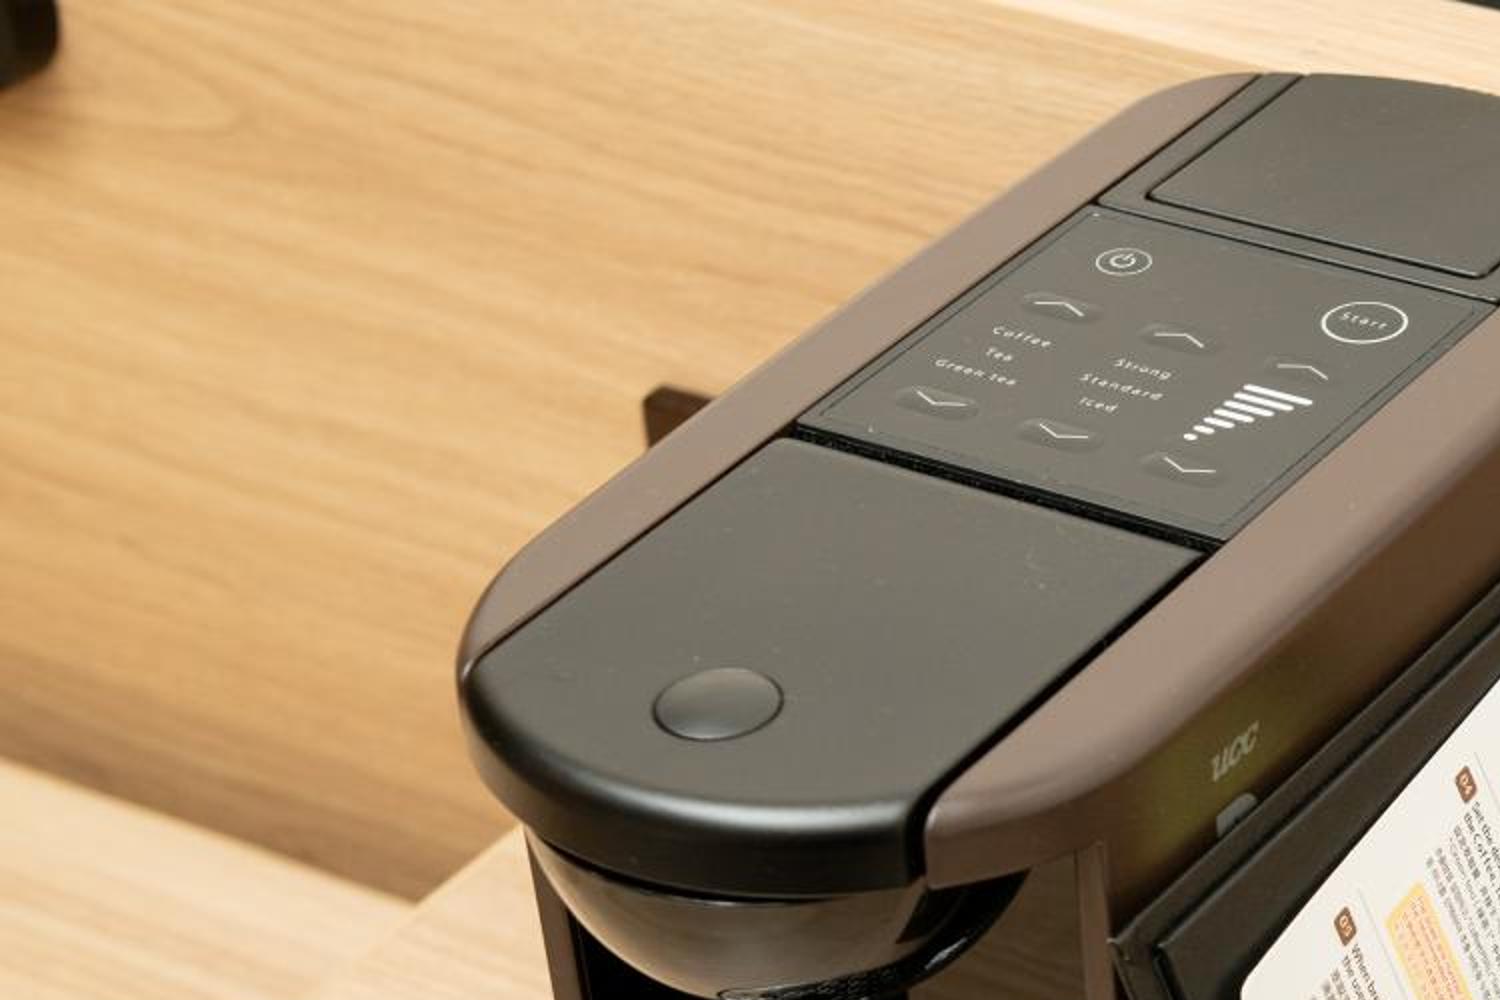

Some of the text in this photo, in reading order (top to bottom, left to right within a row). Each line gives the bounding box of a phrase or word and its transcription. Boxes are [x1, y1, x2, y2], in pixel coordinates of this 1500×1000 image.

[1340, 311, 1388, 329] Start
[992, 326, 1051, 348] Coffee
[986, 347, 1013, 362] Tea
[934, 358, 985, 377] Green
[1114, 357, 1172, 380] Strong
[1080, 373, 1164, 400] Standard
[1079, 397, 1119, 413] Iced
[1351, 943, 1371, 983] When
